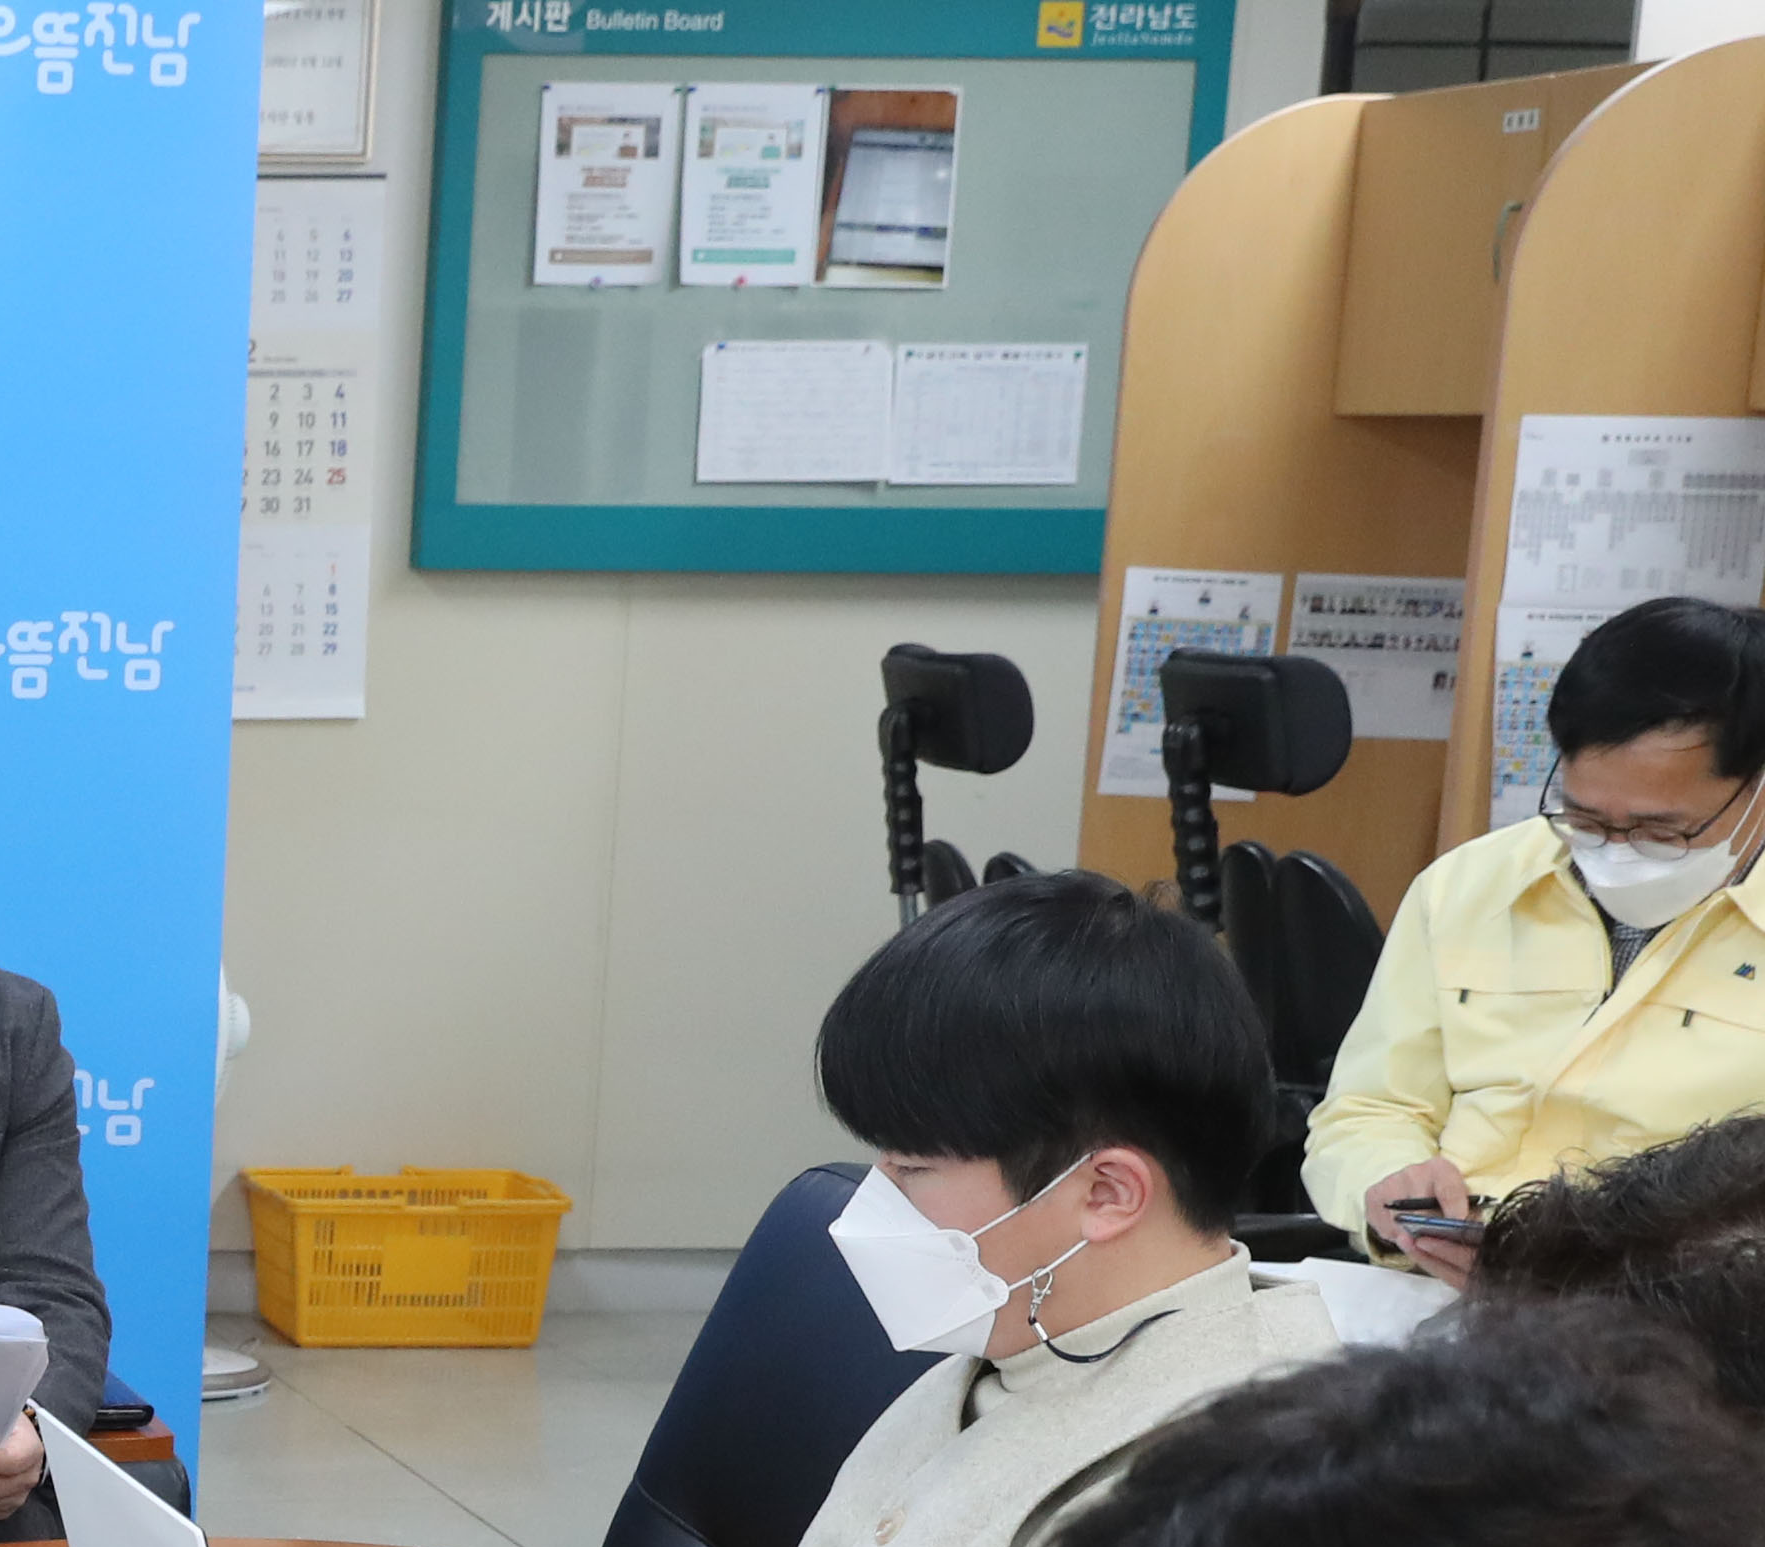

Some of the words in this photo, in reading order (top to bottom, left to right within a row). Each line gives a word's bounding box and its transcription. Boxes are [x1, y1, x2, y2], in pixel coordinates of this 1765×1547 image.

[486, 0, 572, 33] 게시판
[585, 9, 659, 31] Bulletin
[663, 9, 725, 32] Board
[1089, 3, 1197, 31] 전라남도
[269, 382, 280, 402] 2
[302, 382, 314, 402] 3
[334, 382, 346, 402] 4
[269, 410, 279, 429] 9
[298, 410, 316, 429] 10
[330, 410, 347, 429] 11
[263, 439, 281, 458] 16
[296, 439, 315, 458] 17
[329, 439, 348, 458] 18
[261, 467, 281, 487] 23
[293, 467, 314, 487] 24
[326, 467, 347, 487] 25
[260, 496, 281, 515] 30
[293, 496, 312, 515] 31
[325, 602, 338, 617] 15
[322, 622, 338, 637] 22
